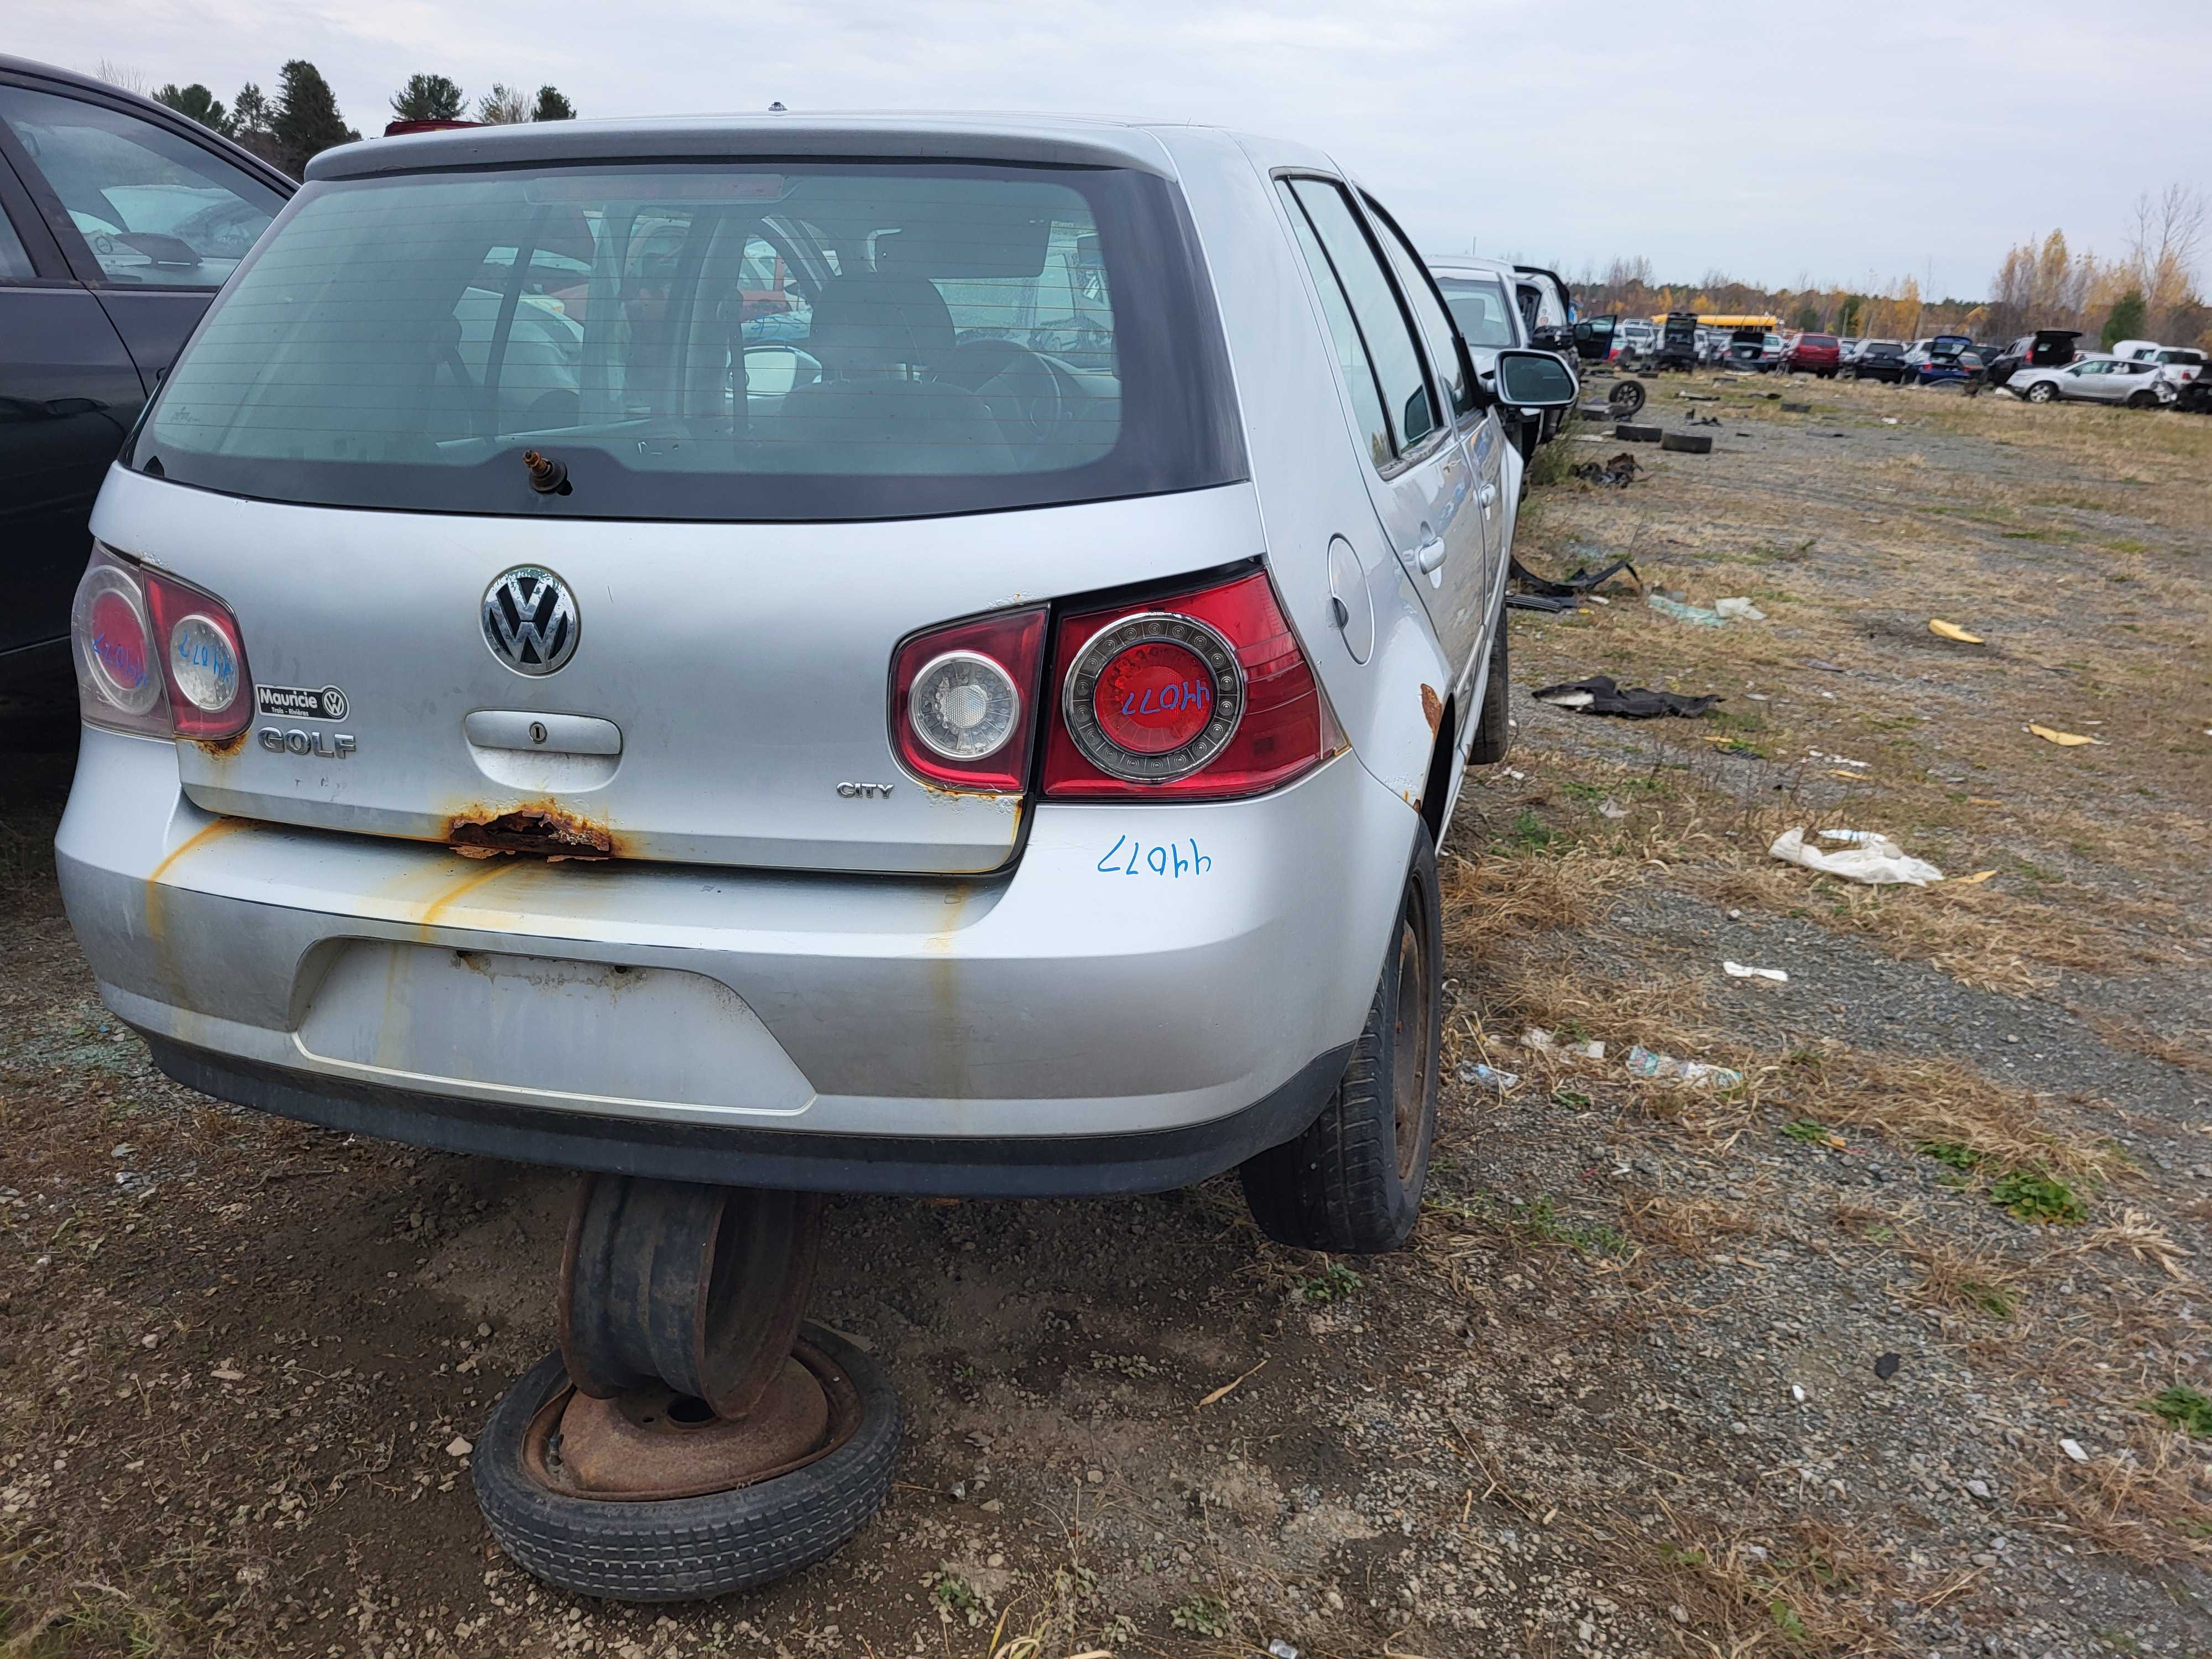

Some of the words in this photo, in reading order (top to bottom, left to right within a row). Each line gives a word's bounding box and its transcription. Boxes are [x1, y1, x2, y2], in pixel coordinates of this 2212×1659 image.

[482, 565, 580, 676] VW
[260, 688, 318, 709] Mauricie
[1122, 679, 1210, 715] 44077
[258, 727, 356, 759] GOLF
[836, 781, 894, 799] CITY
[1098, 835, 1212, 878] 44077
